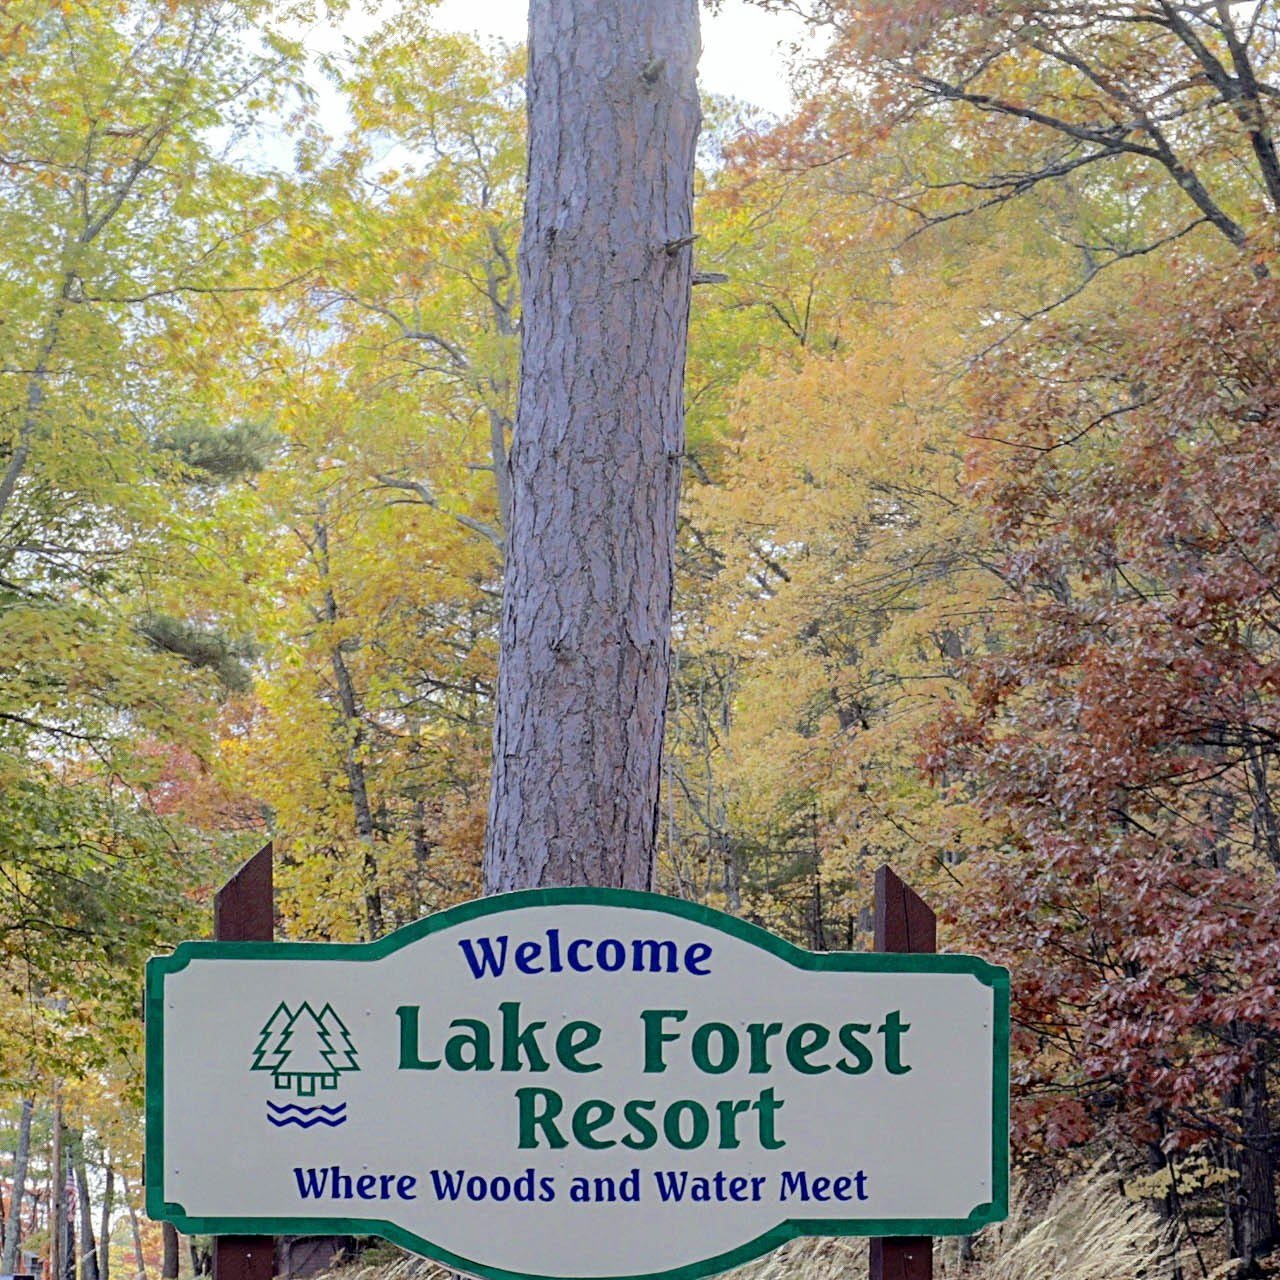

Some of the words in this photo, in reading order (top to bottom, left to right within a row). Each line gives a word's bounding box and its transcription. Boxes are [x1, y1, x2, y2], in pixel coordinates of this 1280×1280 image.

[458, 928, 714, 979] Welcome
[395, 1001, 603, 1074] Lake
[639, 1009, 913, 1076] Forest
[514, 1086, 787, 1151] Resort
[292, 1166, 417, 1201] Where
[429, 1168, 556, 1203] Woods
[569, 1168, 641, 1203] and
[653, 1170, 767, 1202] Water
[779, 1169, 869, 1202] Meet
